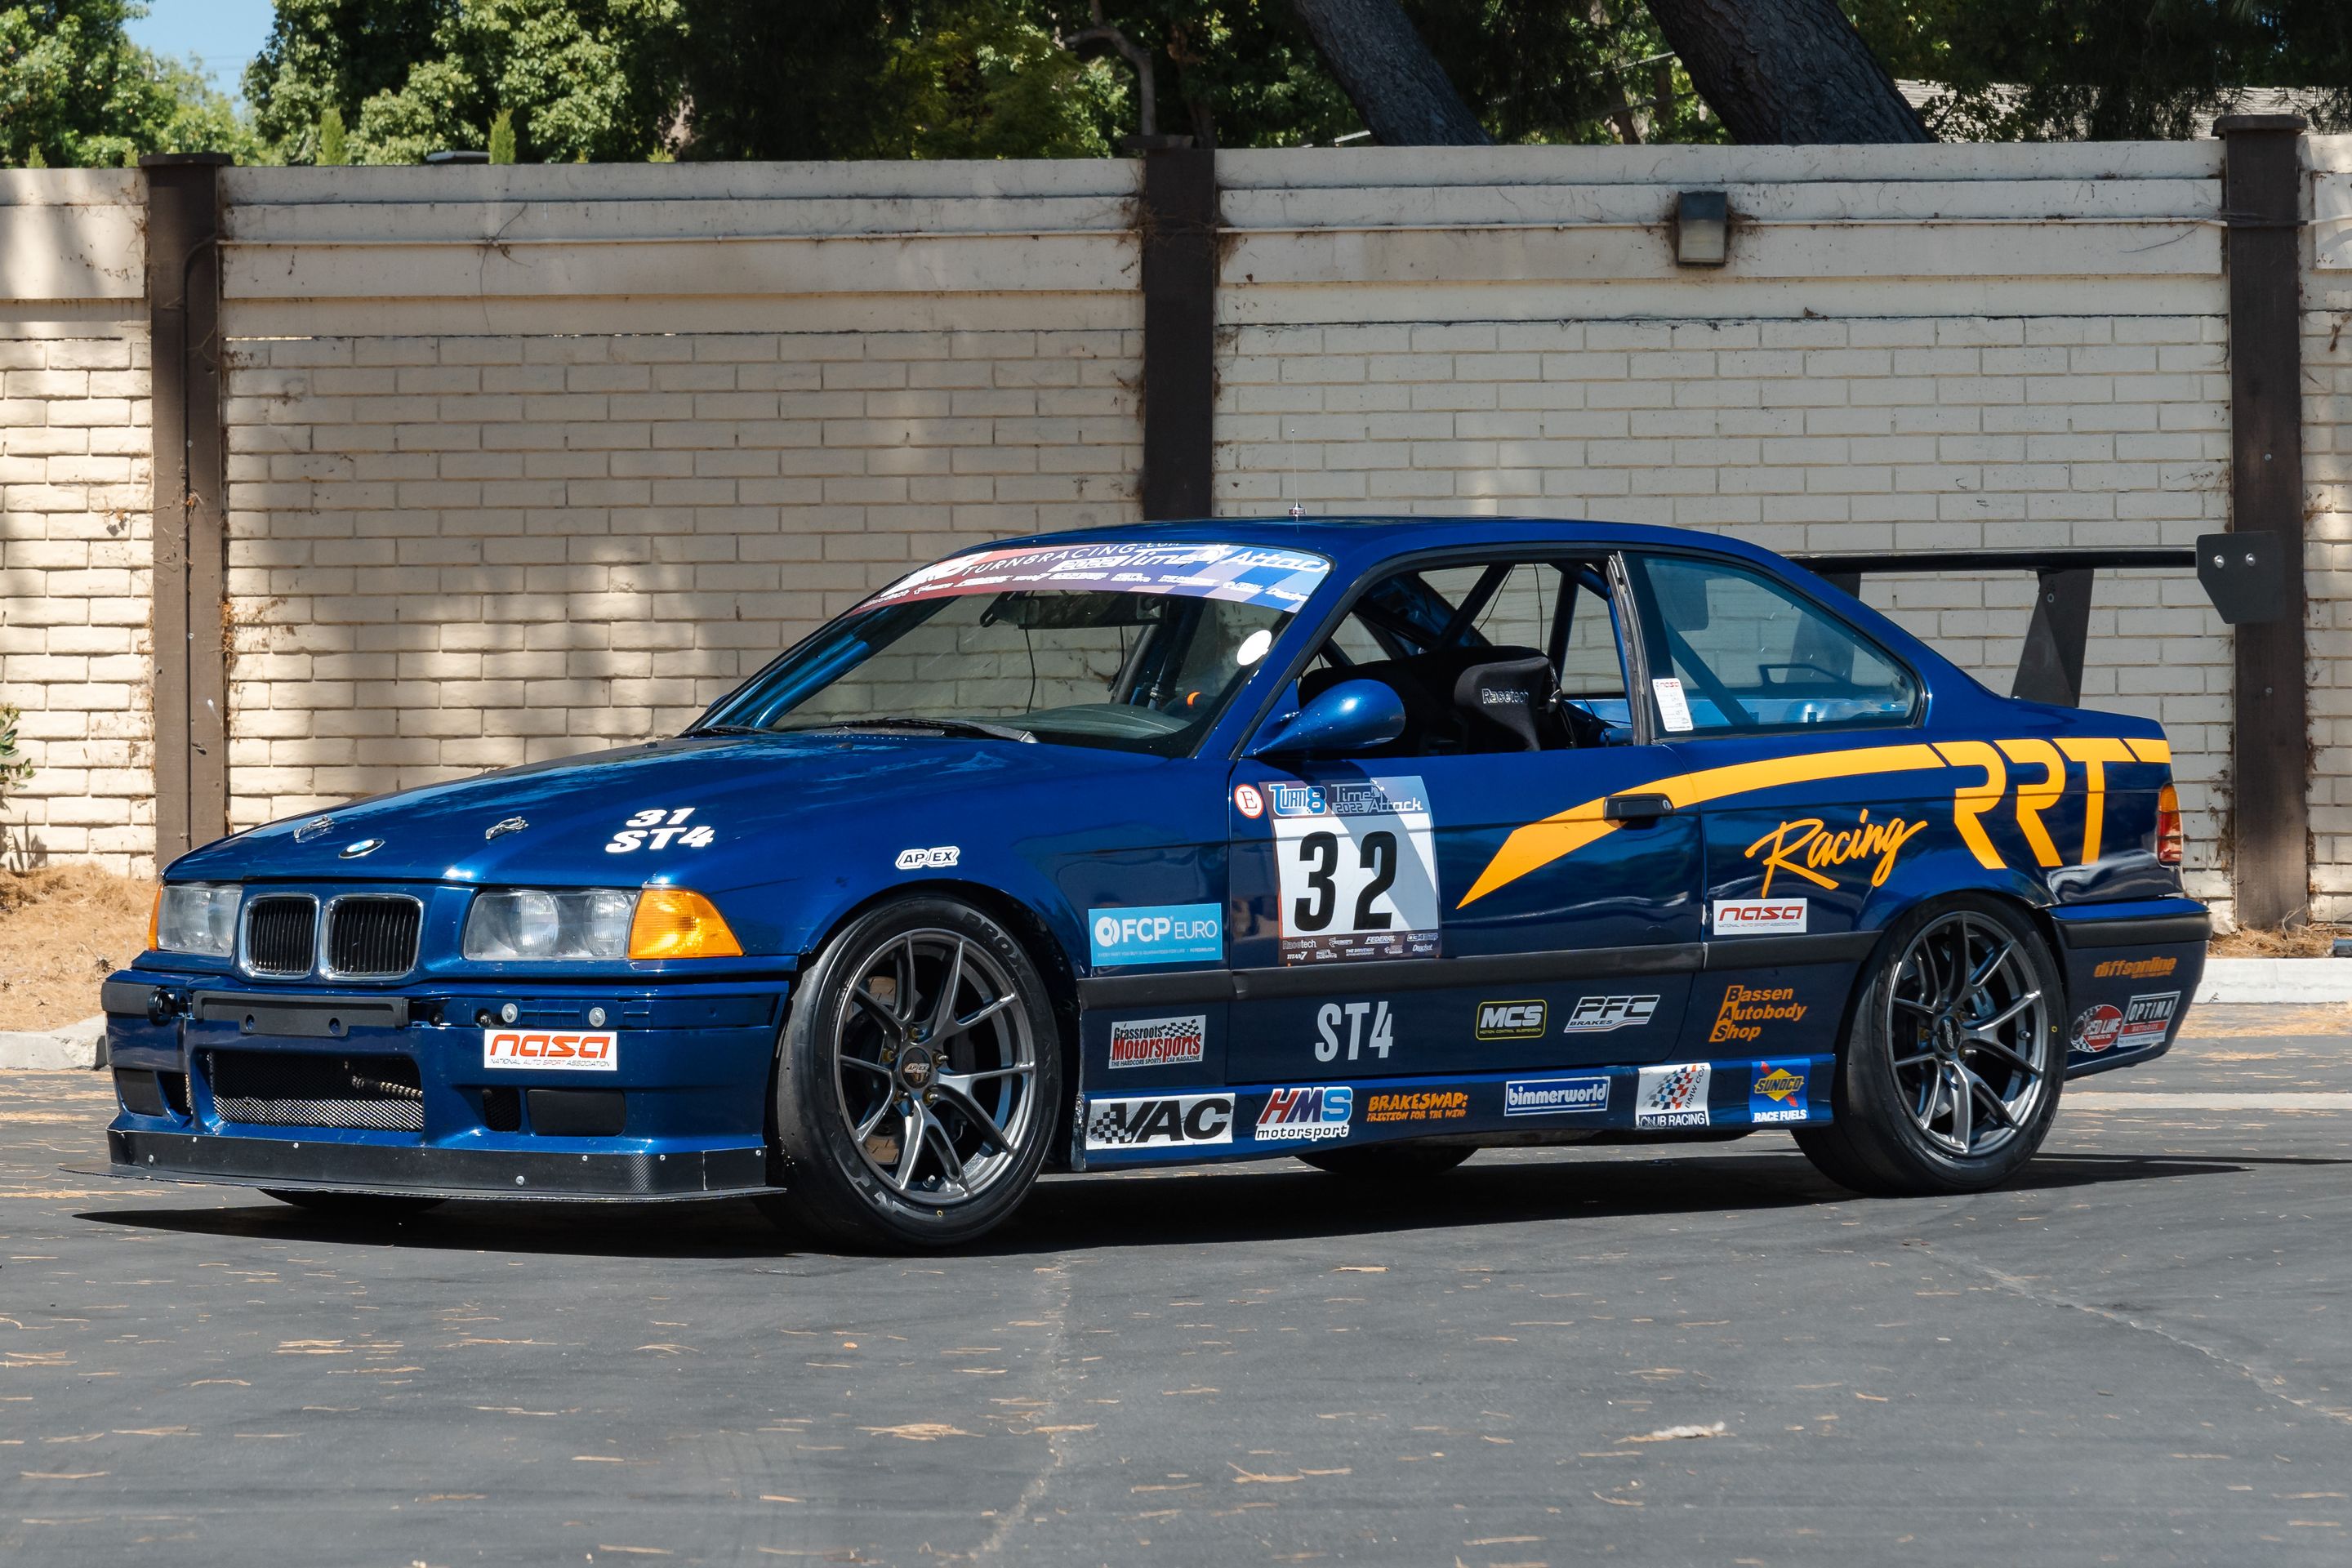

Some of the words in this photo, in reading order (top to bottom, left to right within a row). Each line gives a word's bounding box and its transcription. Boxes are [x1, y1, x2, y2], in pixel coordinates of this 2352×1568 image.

[1240, 791, 1258, 808] E
[1336, 803, 1363, 813] 2022
[1368, 797, 1423, 813] Attack
[1931, 737, 2136, 870] RRT
[626, 807, 696, 827] 31
[605, 826, 715, 853] ST4
[1744, 808, 1928, 899] Racing
[1294, 831, 1397, 932] 32
[1719, 906, 1804, 921] nasa
[1121, 916, 1171, 943] FCP
[1174, 920, 1218, 940] EURO
[1282, 939, 1317, 950] Racetech
[1365, 935, 1396, 943] FEDERAL
[1726, 986, 1794, 1003] Bassen
[1480, 1005, 1544, 1028] MCS
[1572, 996, 1659, 1020] PFC
[1720, 1003, 1807, 1022] Autobody
[2129, 1000, 2173, 1021] OPTIMA
[1114, 1025, 1163, 1040] Grassroots
[1315, 1001, 1393, 1062] ST4
[1714, 1024, 1762, 1042] Shop
[490, 1034, 611, 1058] nasa
[1111, 1034, 1201, 1062] Motorsports
[1508, 1084, 1607, 1106] bimmerworld
[1755, 1077, 1803, 1092] SUNOCO
[1258, 1089, 1352, 1125] HMS
[1685, 1085, 1698, 1108] BMW
[1098, 1098, 1232, 1144] VAC
[1366, 1111, 1409, 1122] FRICTION
[1668, 1113, 1705, 1126] RACING
[1753, 1111, 1779, 1123] RACE
[1780, 1109, 1807, 1121] FUELS
[1258, 1125, 1348, 1139] motorsport
